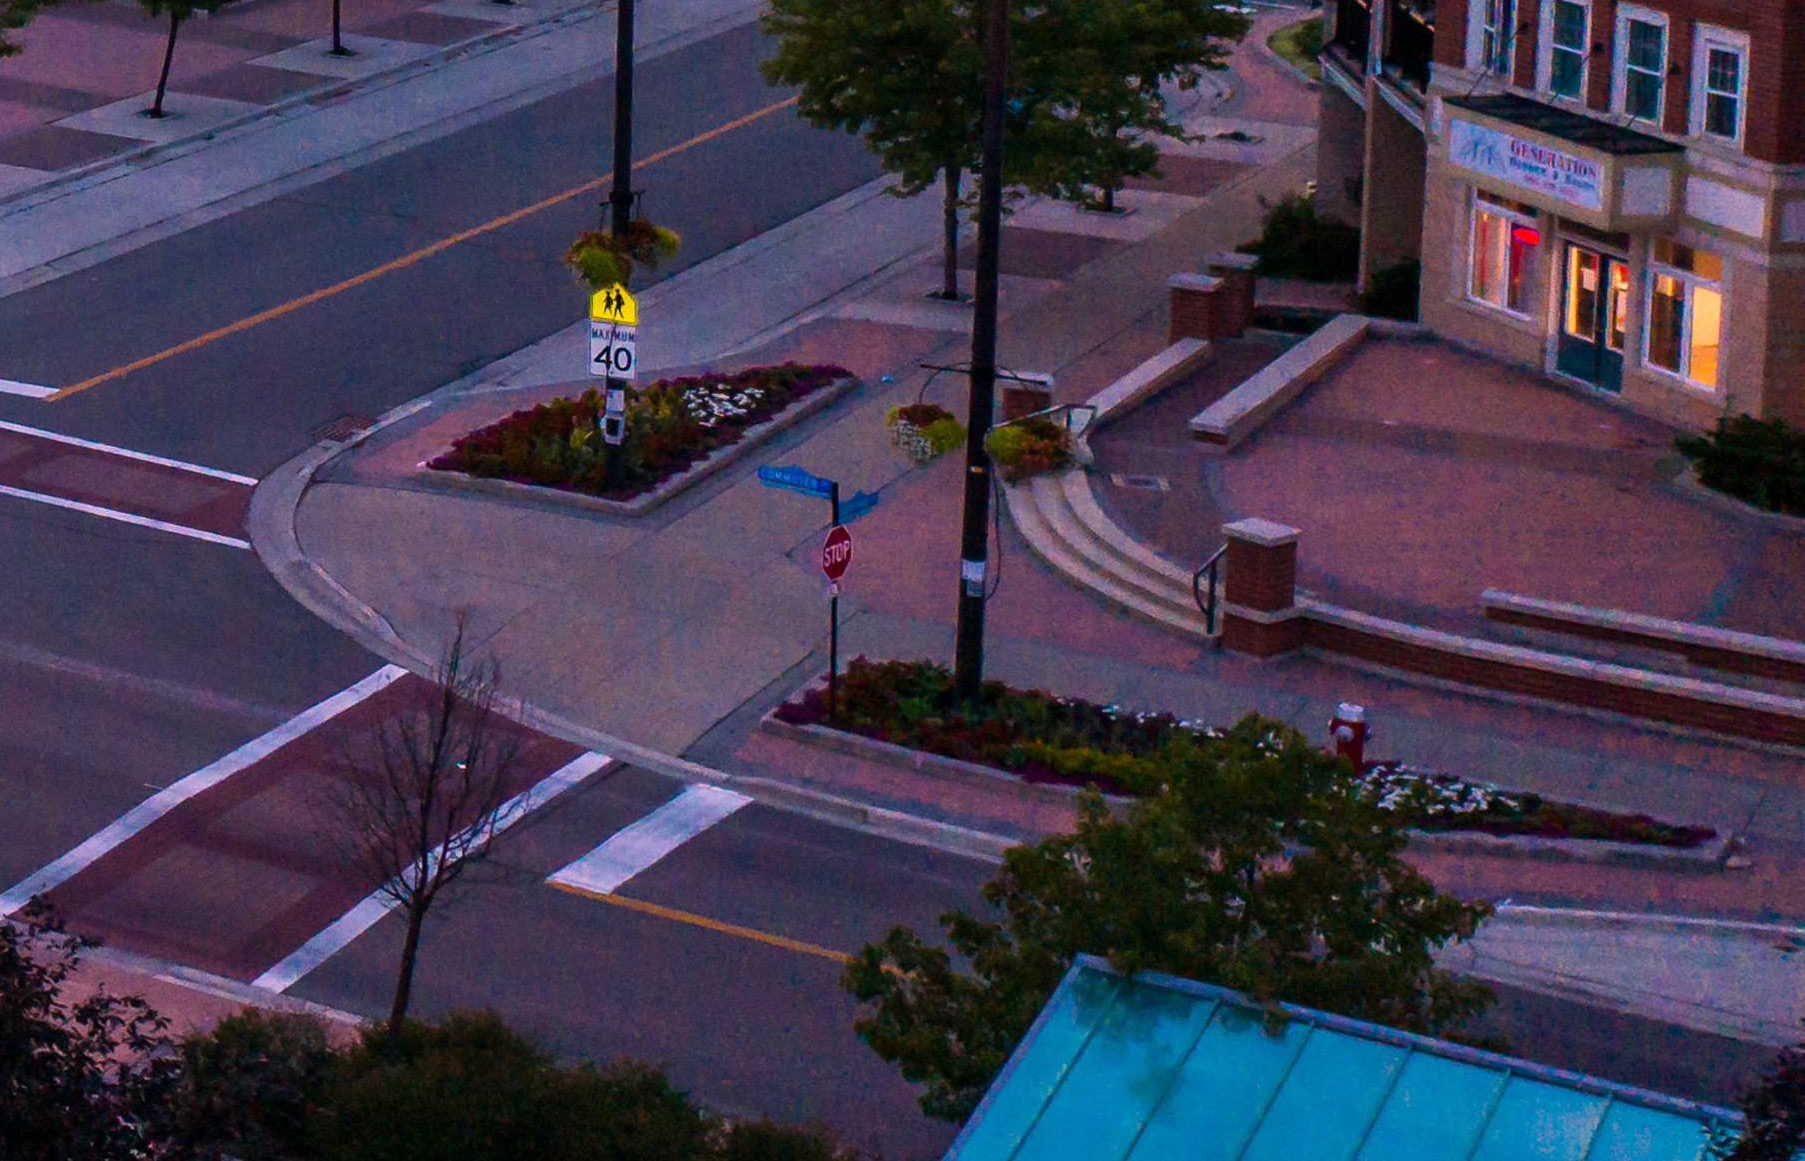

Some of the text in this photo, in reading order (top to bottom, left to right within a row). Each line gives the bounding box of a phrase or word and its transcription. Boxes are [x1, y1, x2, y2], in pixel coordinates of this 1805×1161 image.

[1510, 140, 1597, 178] GENERATION
[594, 345, 632, 371] 40
[823, 540, 851, 567] STOP
